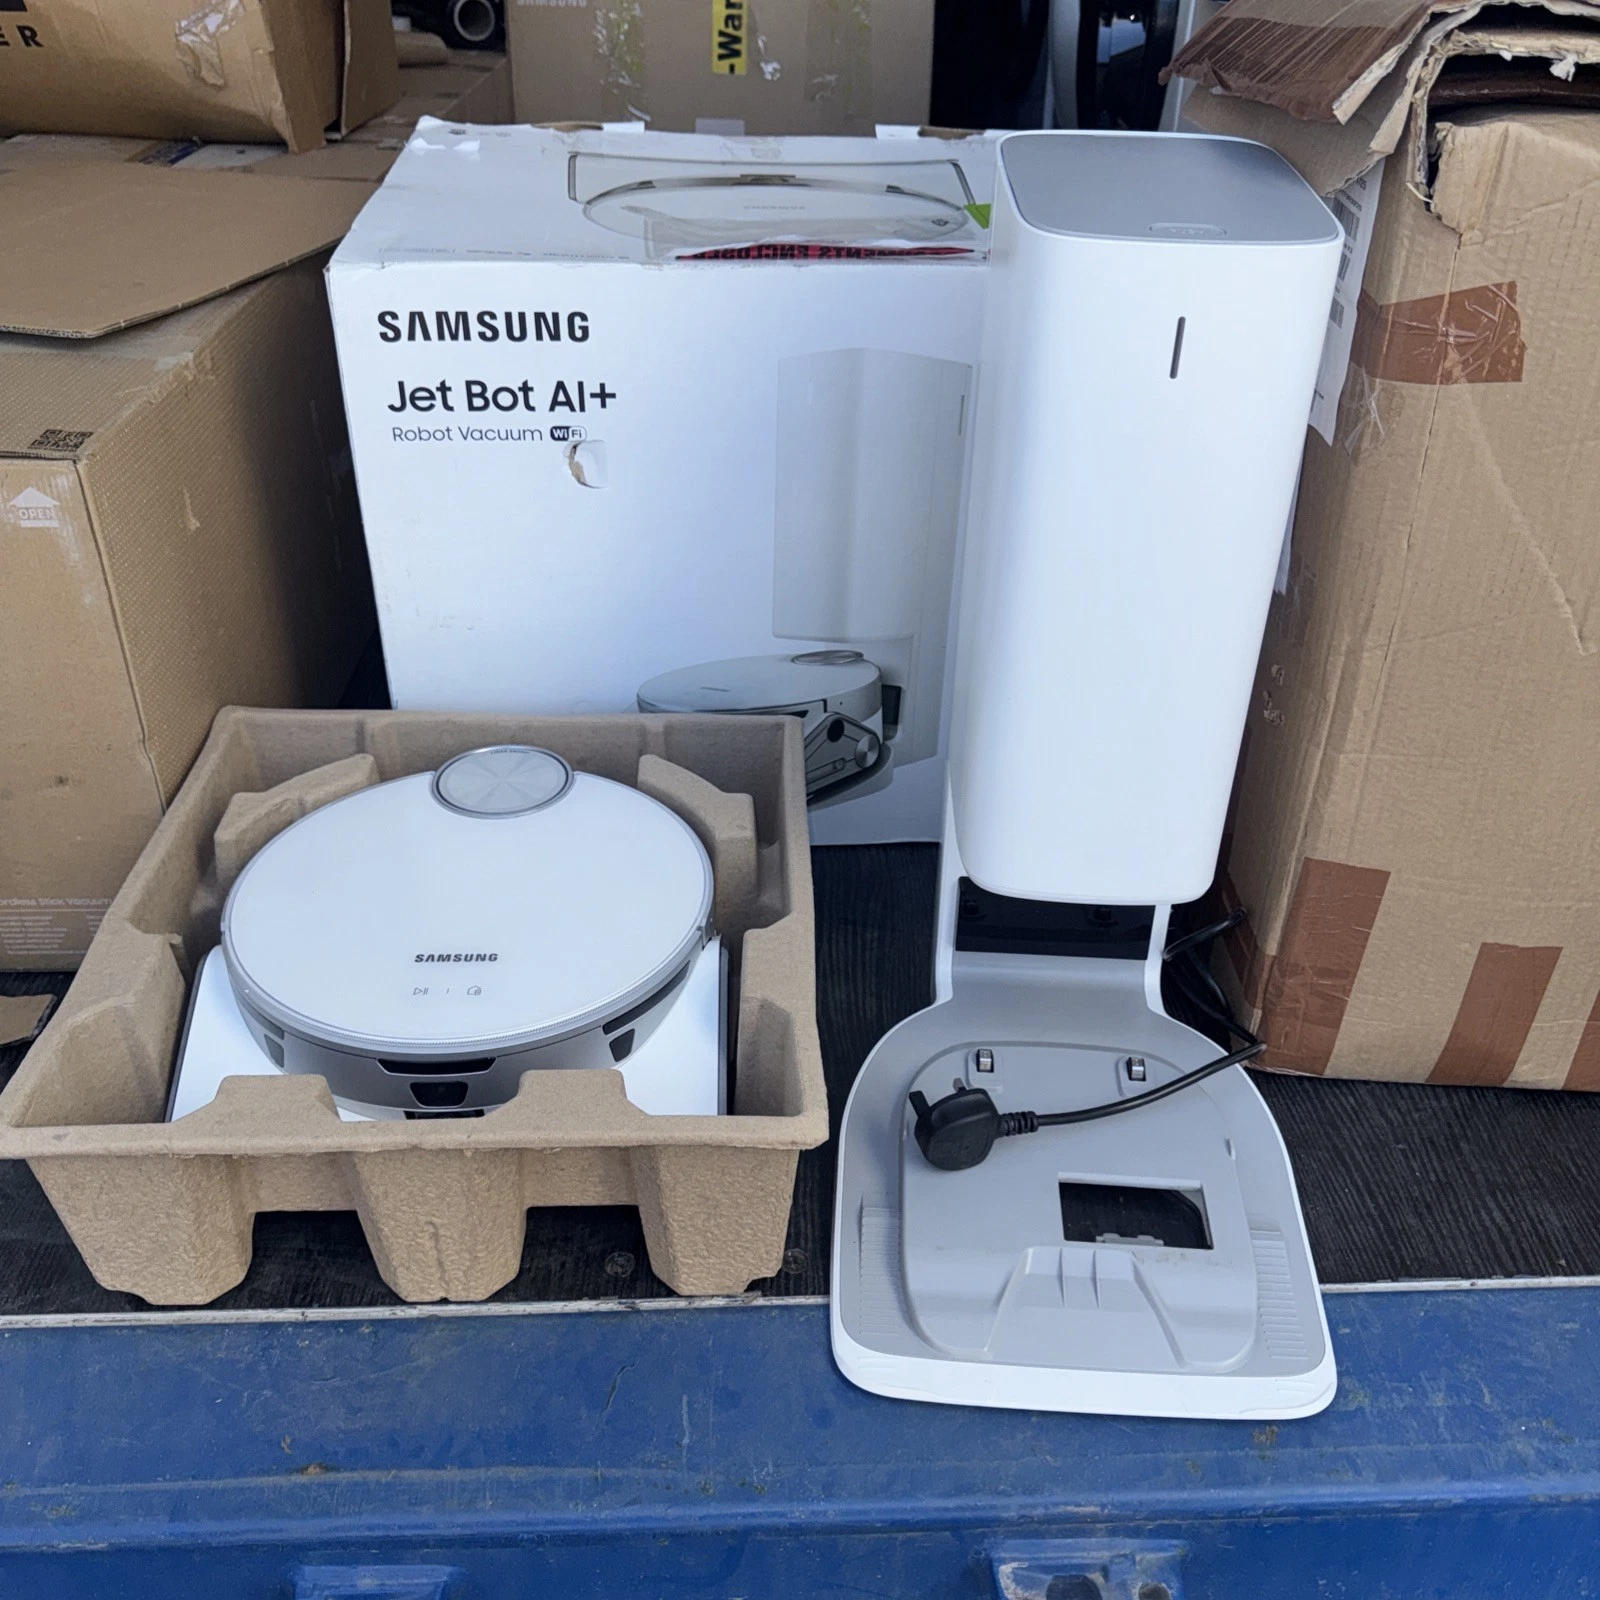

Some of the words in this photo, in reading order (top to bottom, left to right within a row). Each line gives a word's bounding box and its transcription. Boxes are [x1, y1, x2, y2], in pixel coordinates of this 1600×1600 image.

[377, 310, 590, 343] SAMSUNG
[387, 379, 455, 413] Jet
[465, 379, 536, 413] Bot
[548, 380, 617, 413] AI+
[392, 426, 453, 442] Robot
[457, 426, 543, 442] Vacuum
[19, 508, 56, 520] OPEN
[414, 953, 498, 963] SAMSUNG
